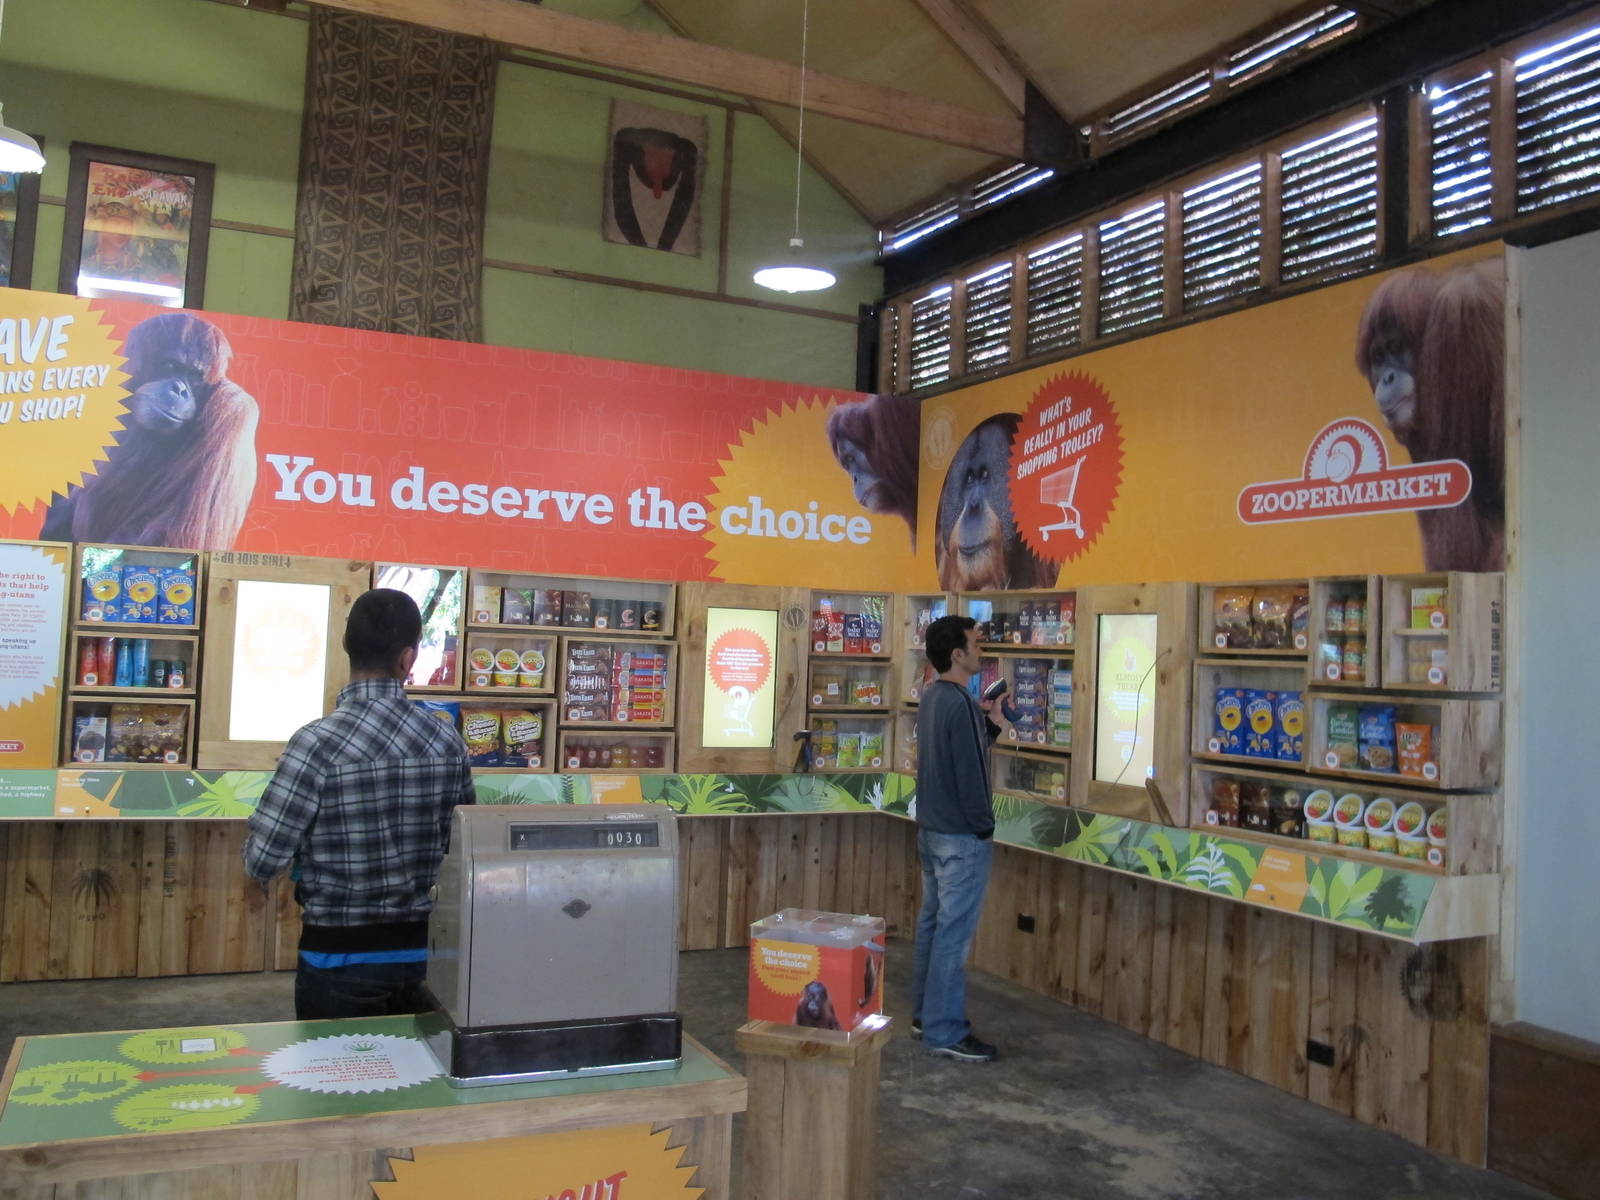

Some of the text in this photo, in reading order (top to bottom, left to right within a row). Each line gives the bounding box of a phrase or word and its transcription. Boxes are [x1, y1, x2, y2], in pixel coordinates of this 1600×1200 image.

[42, 364, 112, 391] EVERY
[20, 394, 86, 422] SHOP!
[1040, 396, 1072, 427] WHAT'S
[1024, 407, 1092, 456] REALLY IN YOUR
[1017, 423, 1104, 480] SHOPPING TROLLEY?
[266, 453, 872, 545] You deserve the choice
[1252, 473, 1452, 514] ZOOPERMARKET
[221, 551, 284, 567] THIS SIDE UP
[29, 583, 49, 591] help
[607, 832, 642, 846] 0030
[761, 947, 813, 961] You deserve
[764, 957, 778, 966] the
[778, 959, 808, 969] choice
